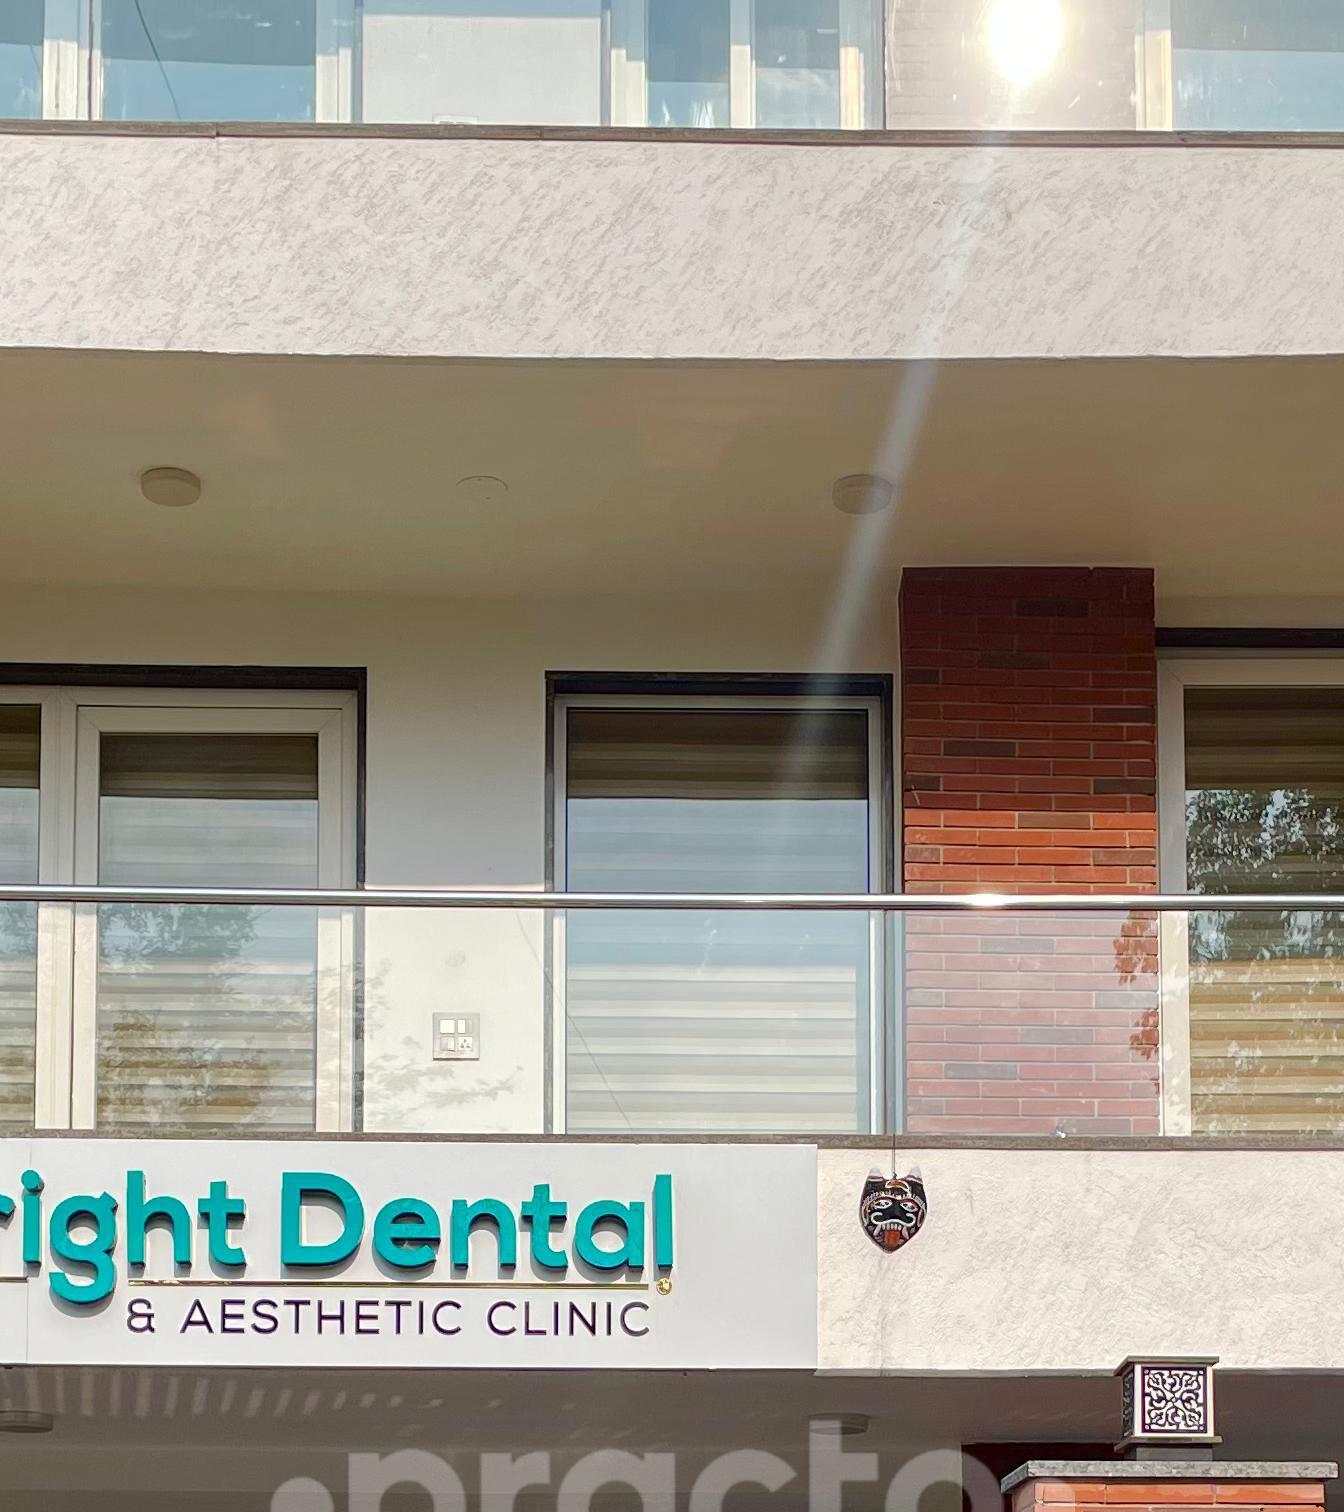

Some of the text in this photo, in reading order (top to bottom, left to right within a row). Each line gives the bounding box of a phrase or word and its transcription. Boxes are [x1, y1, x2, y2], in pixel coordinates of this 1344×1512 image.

[281, 1171, 674, 1272] Dental
[126, 1298, 652, 1338] & AESTHETIC CLINIC
